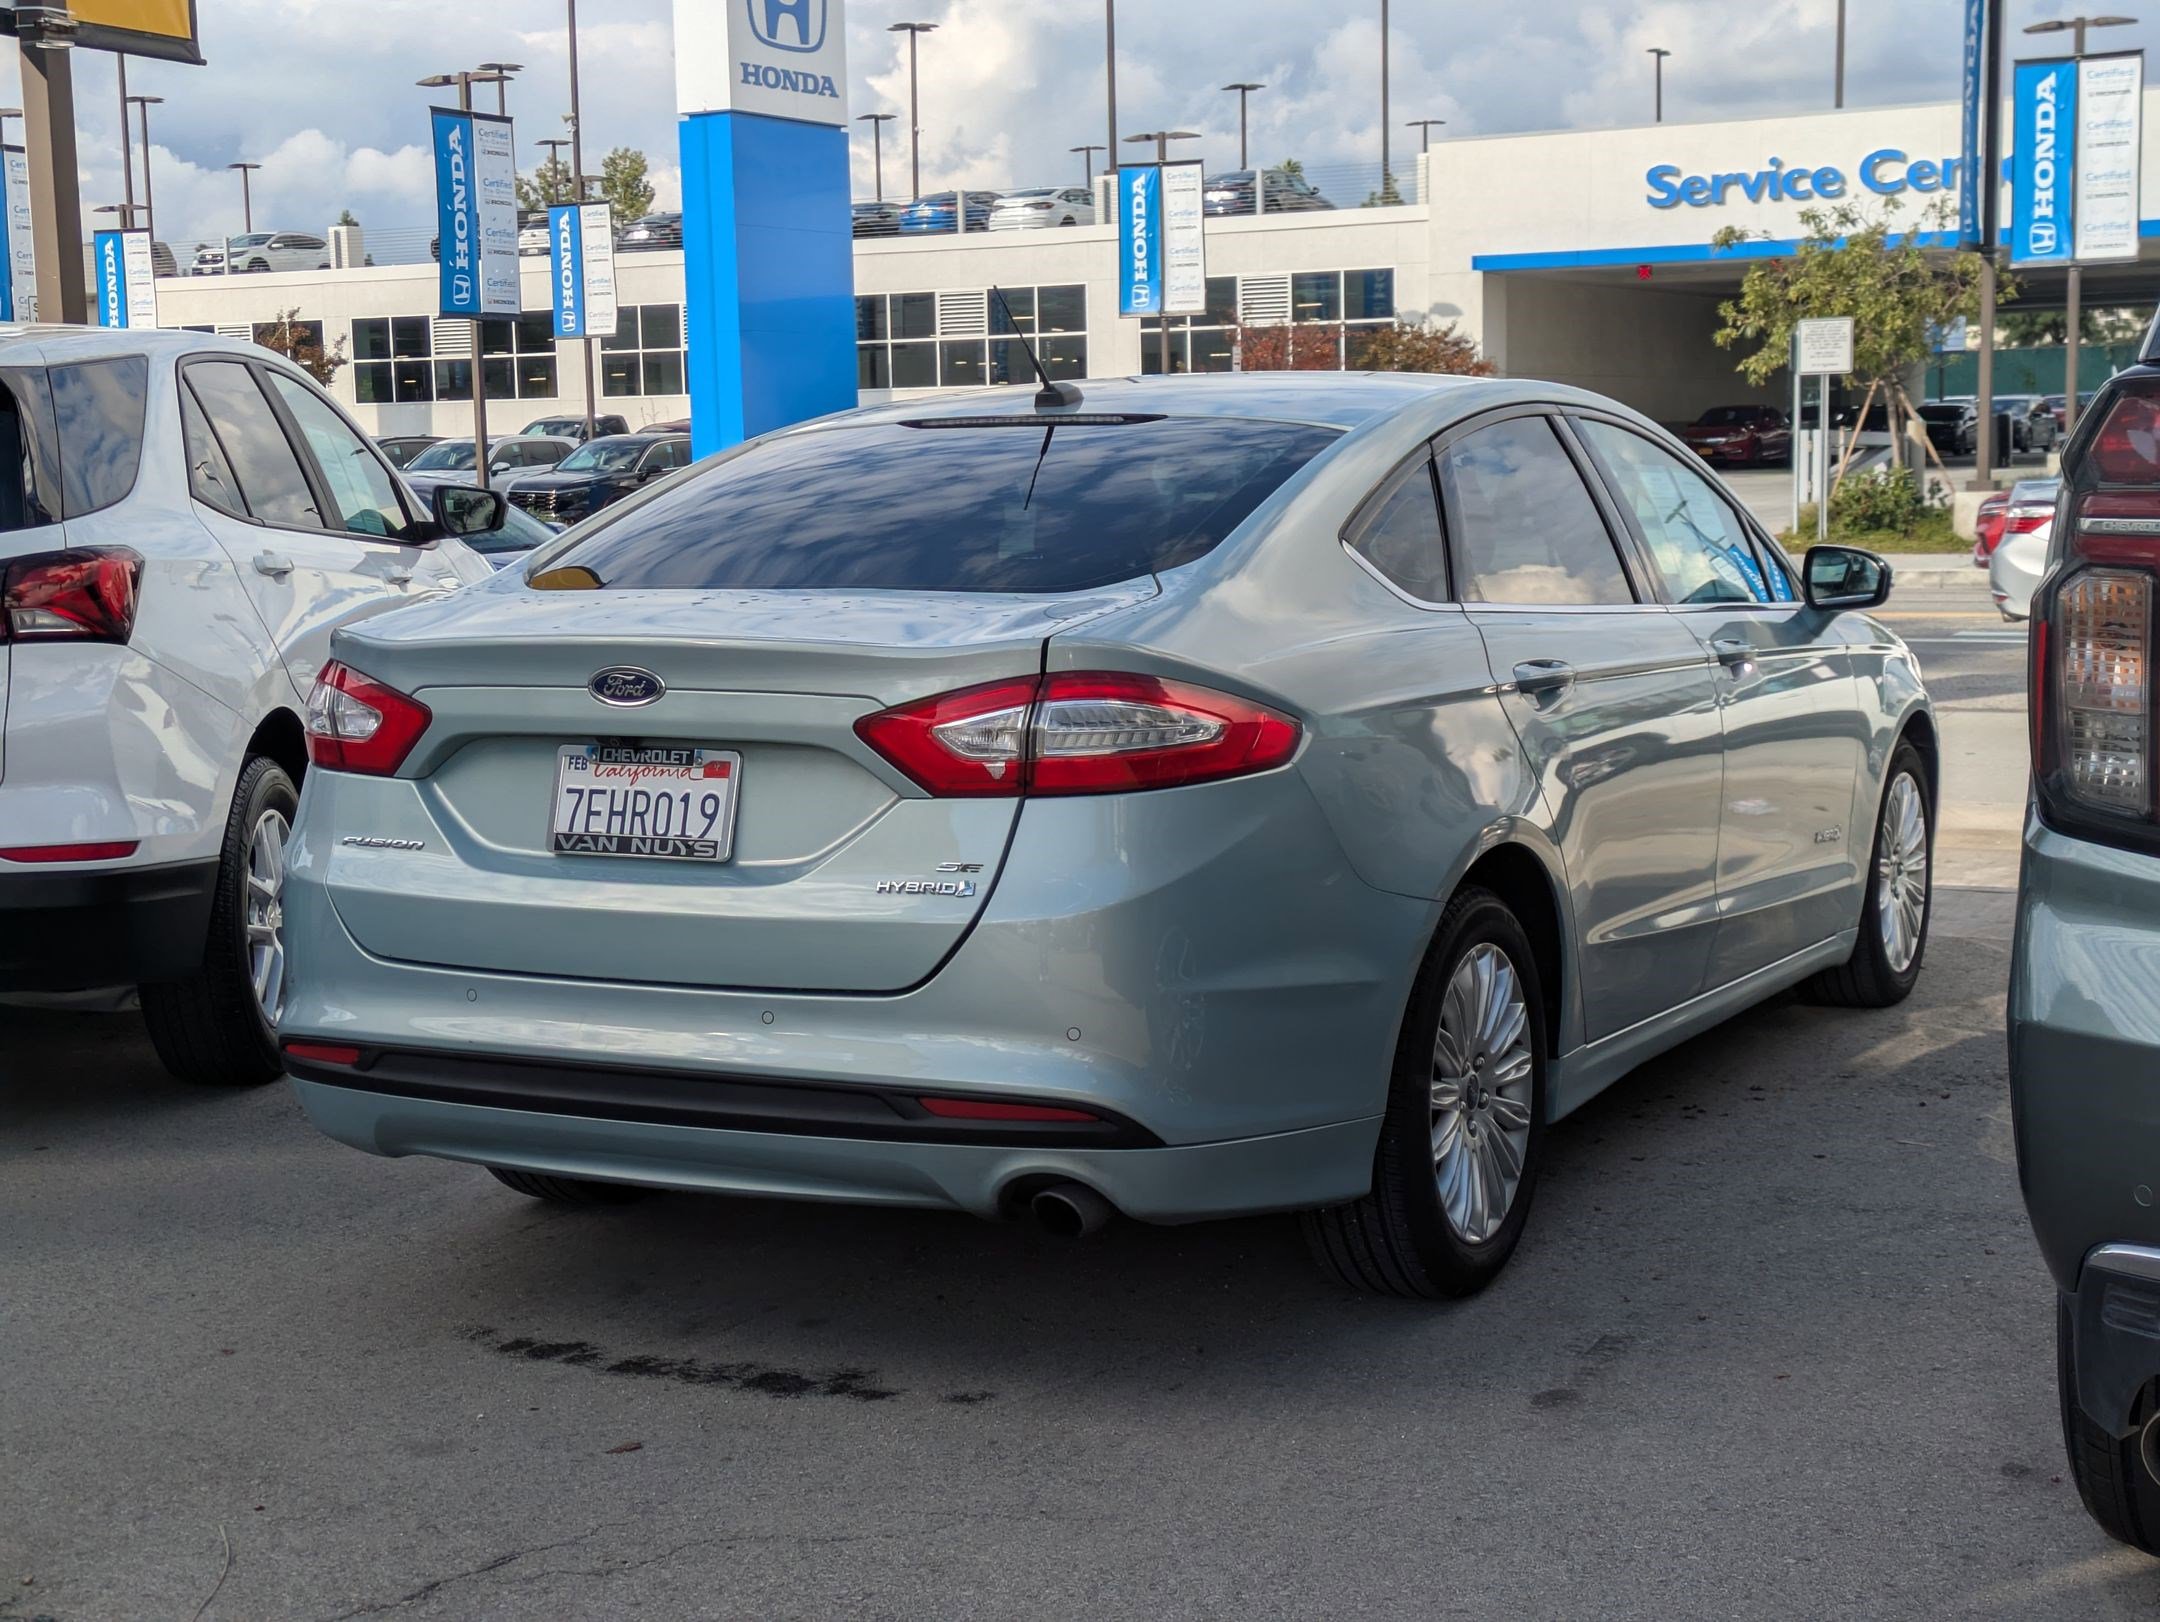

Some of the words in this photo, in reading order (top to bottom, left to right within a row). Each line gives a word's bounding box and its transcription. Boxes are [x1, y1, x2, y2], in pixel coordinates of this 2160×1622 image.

[740, 62, 839, 98] HONDA
[479, 128, 508, 139] Certified
[2034, 71, 2057, 219] HONDA
[483, 178, 512, 189] Certified
[1646, 156, 1844, 207] Service
[448, 124, 469, 270] HONDA
[486, 228, 515, 238] Certified
[1132, 173, 1148, 281] HONDA
[559, 210, 573, 309] HONDA
[104, 238, 120, 328] HONDA
[487, 278, 516, 287] Certified
[603, 674, 647, 697] Ford
[568, 757, 588, 771] FEB
[602, 748, 690, 764] CHEVROLET
[566, 787, 721, 839] 7EHR019
[557, 835, 618, 853] VAN
[630, 838, 716, 857] NUYS
[936, 862, 984, 873] SE
[876, 881, 957, 896] HYBRID
